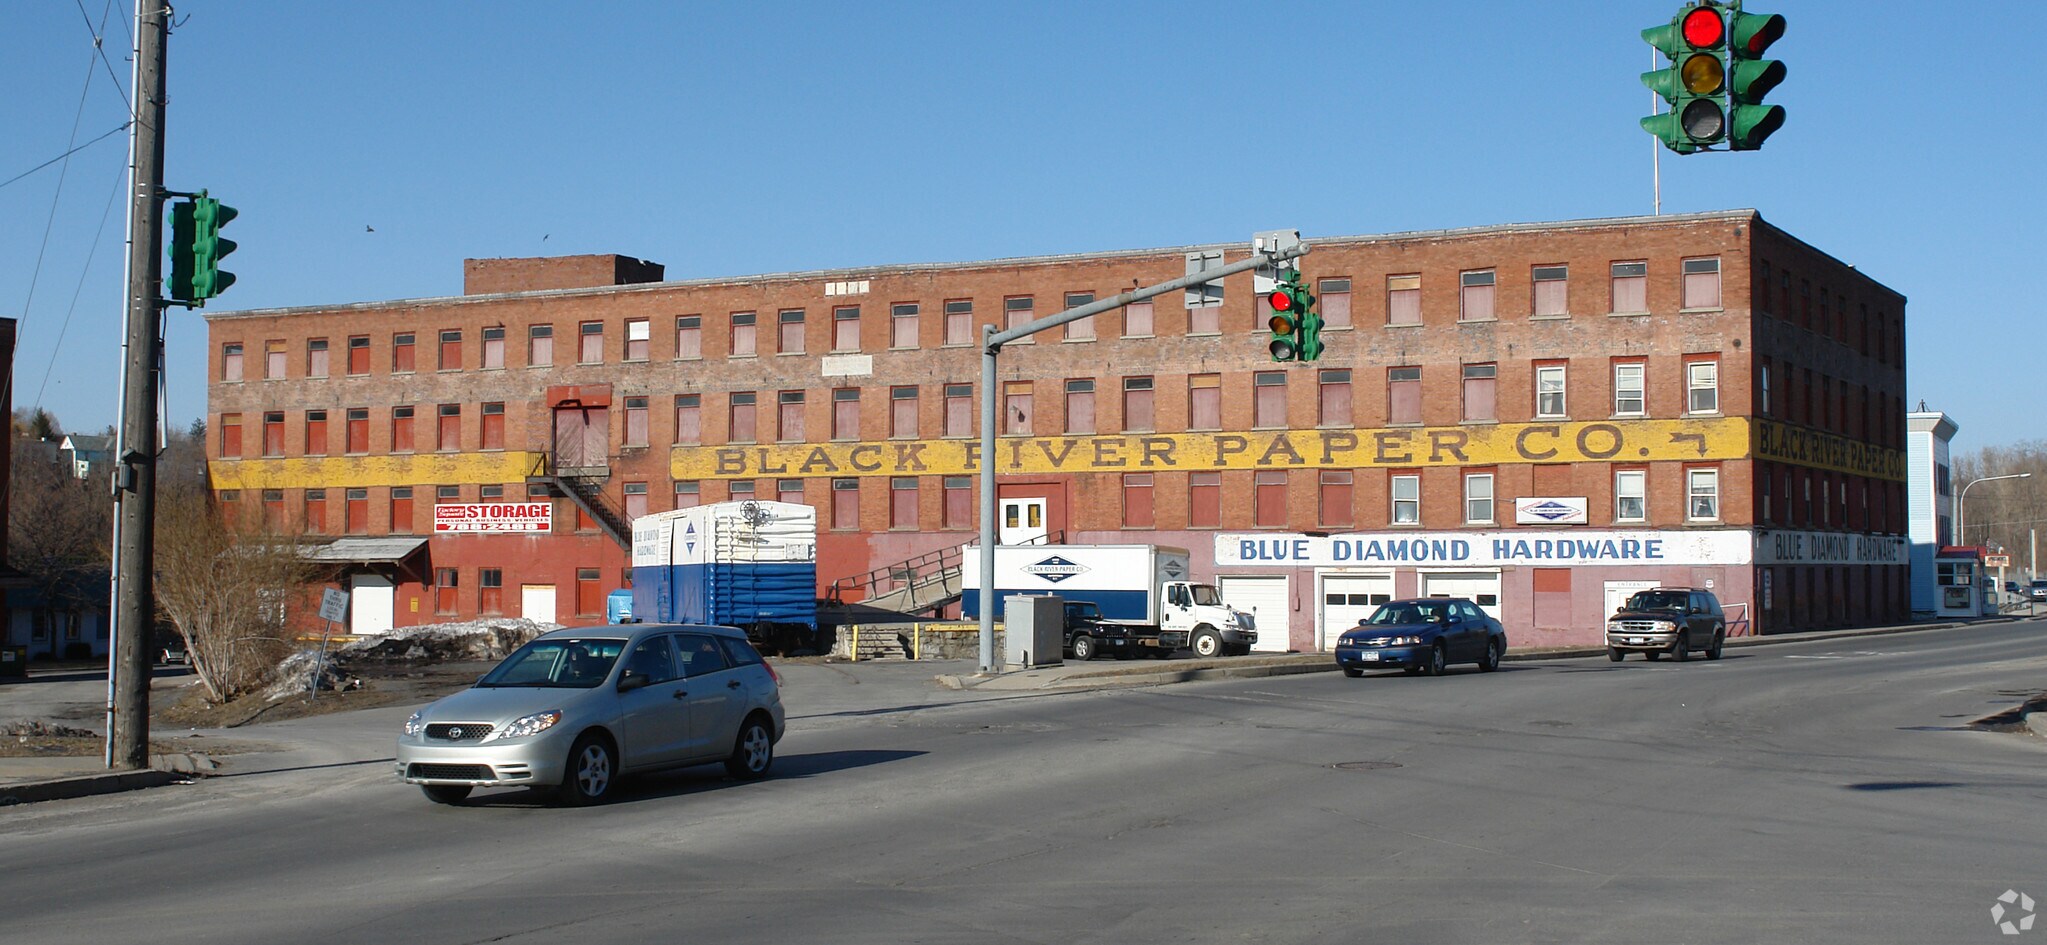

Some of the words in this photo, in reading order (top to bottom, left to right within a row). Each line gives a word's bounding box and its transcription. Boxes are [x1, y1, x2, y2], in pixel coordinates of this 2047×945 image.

[715, 444, 927, 474] BLACK
[1213, 430, 1469, 466] PAPER
[1515, 423, 1650, 460] CO.
[1759, 422, 1808, 461] BLACK
[1811, 434, 1848, 468] RIVER
[1850, 442, 1886, 475] PAPER
[467, 505, 550, 517] STORAGE
[1240, 539, 1310, 561] BLUE
[1332, 539, 1471, 561] DIAMOND
[1492, 538, 1665, 560] HARDWARE
[1775, 533, 1803, 561] BLUE
[1810, 535, 1850, 561] DIAMOND
[1856, 537, 1898, 562] HARDWARE
